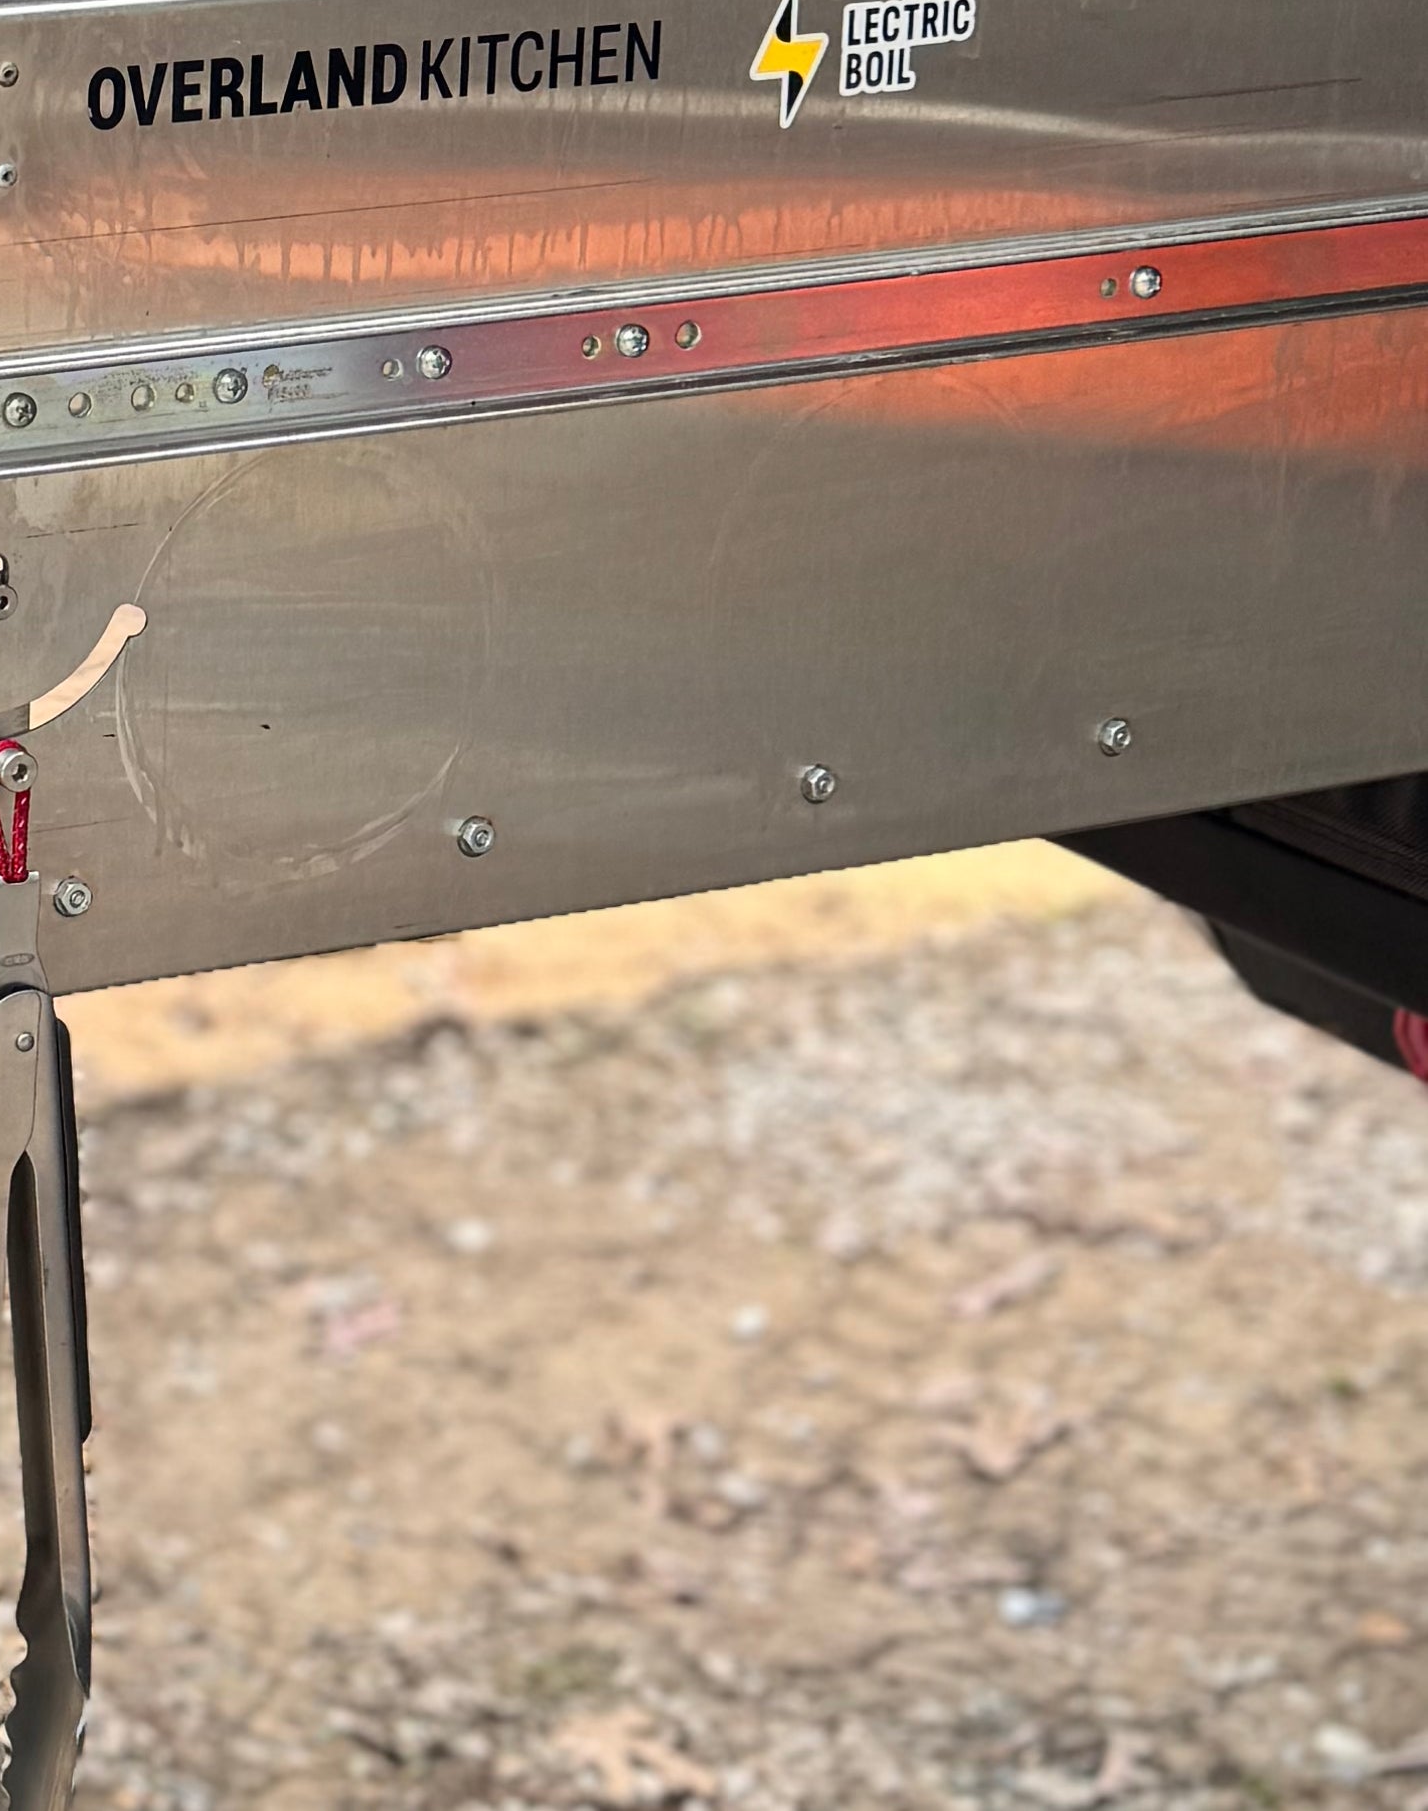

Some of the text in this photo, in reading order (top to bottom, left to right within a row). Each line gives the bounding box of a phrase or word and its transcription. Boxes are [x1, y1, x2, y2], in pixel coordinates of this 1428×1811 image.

[87, 20, 662, 131] OVERLAND KITCHEN
[845, 48, 911, 90] BOIL
